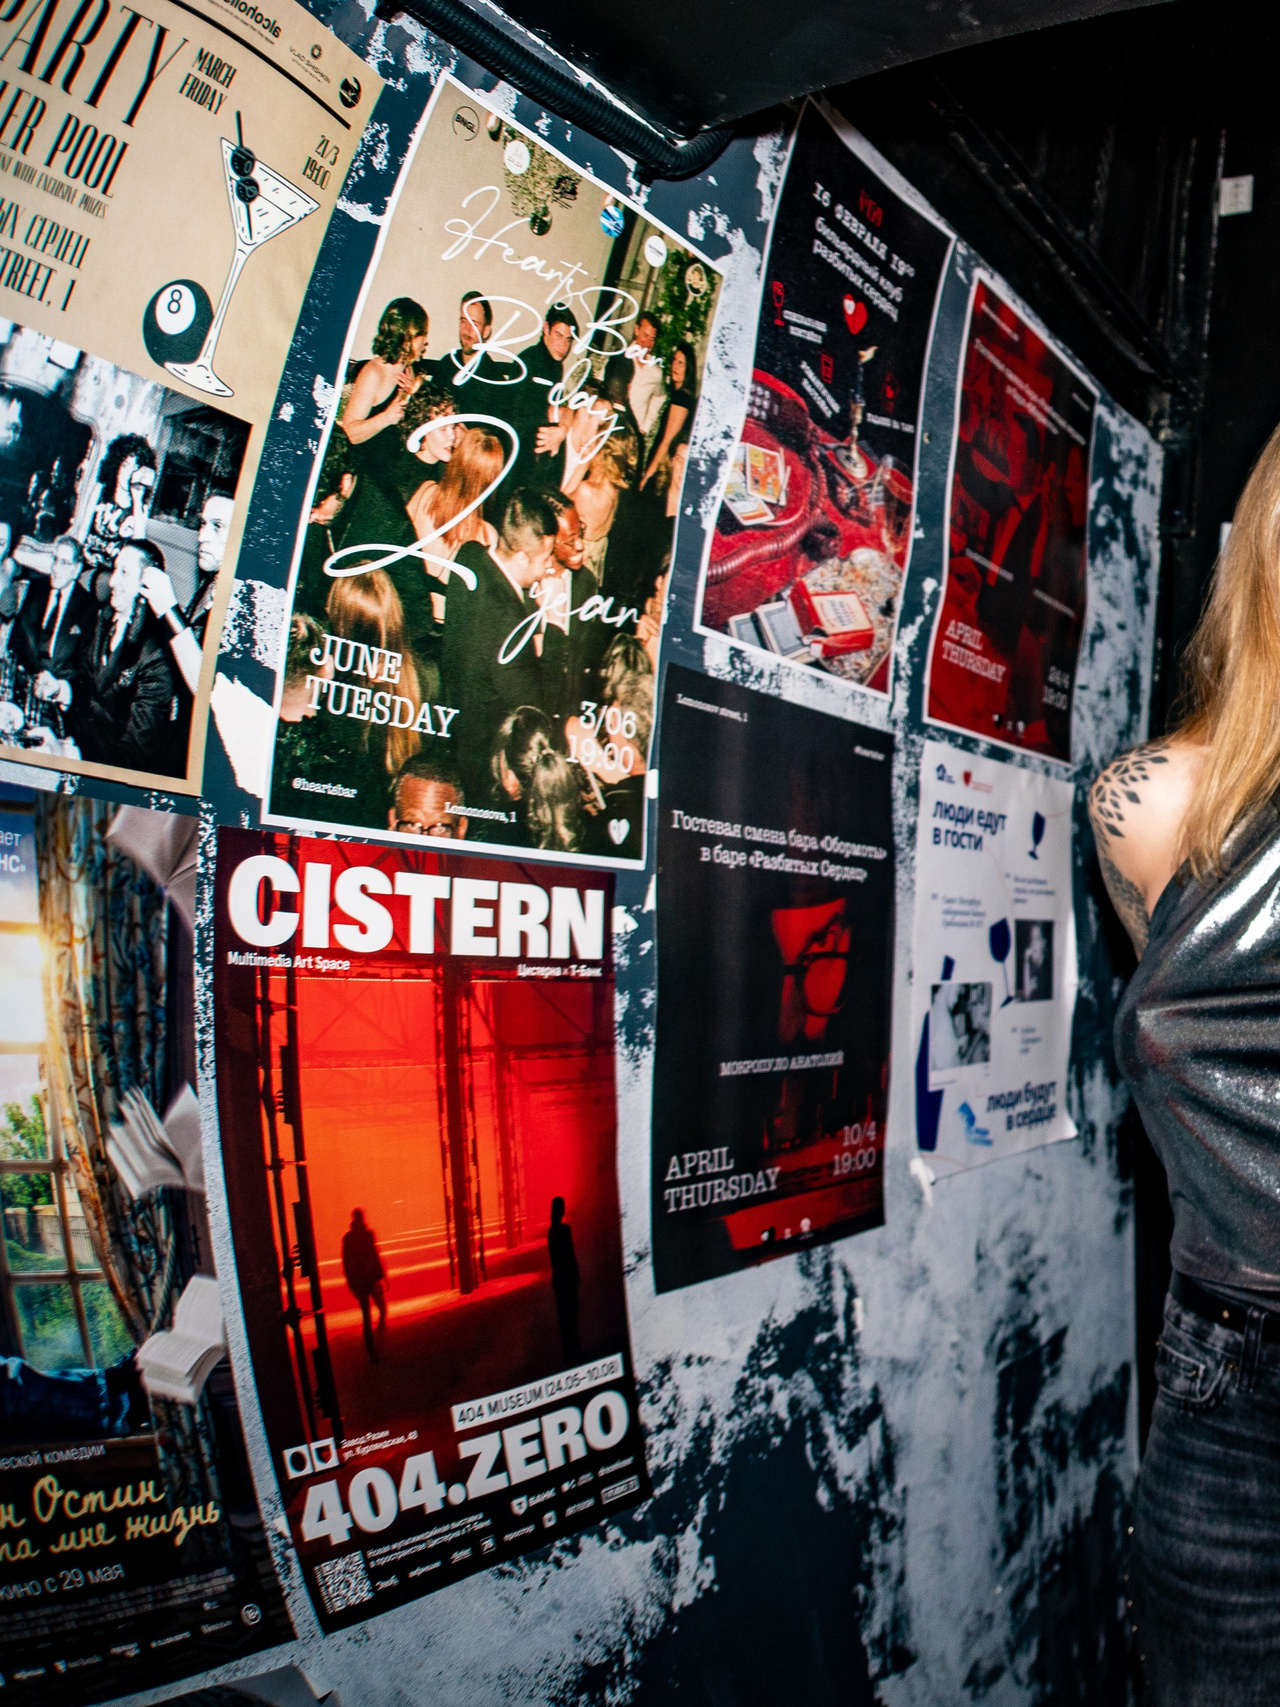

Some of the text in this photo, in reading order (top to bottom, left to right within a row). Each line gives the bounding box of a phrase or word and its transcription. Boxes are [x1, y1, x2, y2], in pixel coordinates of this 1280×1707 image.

[192, 47, 238, 89] MARCH
[179, 73, 229, 115] FRIDAY
[43, 112, 130, 199] POOL
[0, 245, 58, 308] TREET,
[167, 289, 183, 314] 8
[309, 633, 402, 684] JUNE
[304, 675, 460, 739] TUESDAY
[579, 699, 638, 738] 3/06
[566, 733, 635, 775] 19:00
[292, 777, 358, 799] @heartsbar
[443, 801, 507, 822] Lomonosova,
[671, 809, 743, 839] Гостевая
[744, 820, 788, 846] смена
[788, 828, 819, 853] бара
[700, 846, 711, 862] в
[713, 843, 747, 870] баре
[228, 854, 605, 961] CISTERN
[227, 949, 351, 972] Multimedia Art Space
[517, 963, 562, 978] Цистерна
[842, 1120, 877, 1147] 10/4
[664, 1146, 735, 1182] APRIL
[664, 1165, 781, 1214] THURSDAY
[456, 1402, 486, 1425] 404
[487, 1385, 544, 1416] MUSEUM
[301, 1389, 630, 1547] 404.ZERO
[33, 1474, 166, 1523] Остин
[50, 1523, 117, 1554] мне
[125, 1500, 221, 1547] жизнь
[58, 1568, 85, 1591] 29
[89, 1563, 125, 1585] мая
